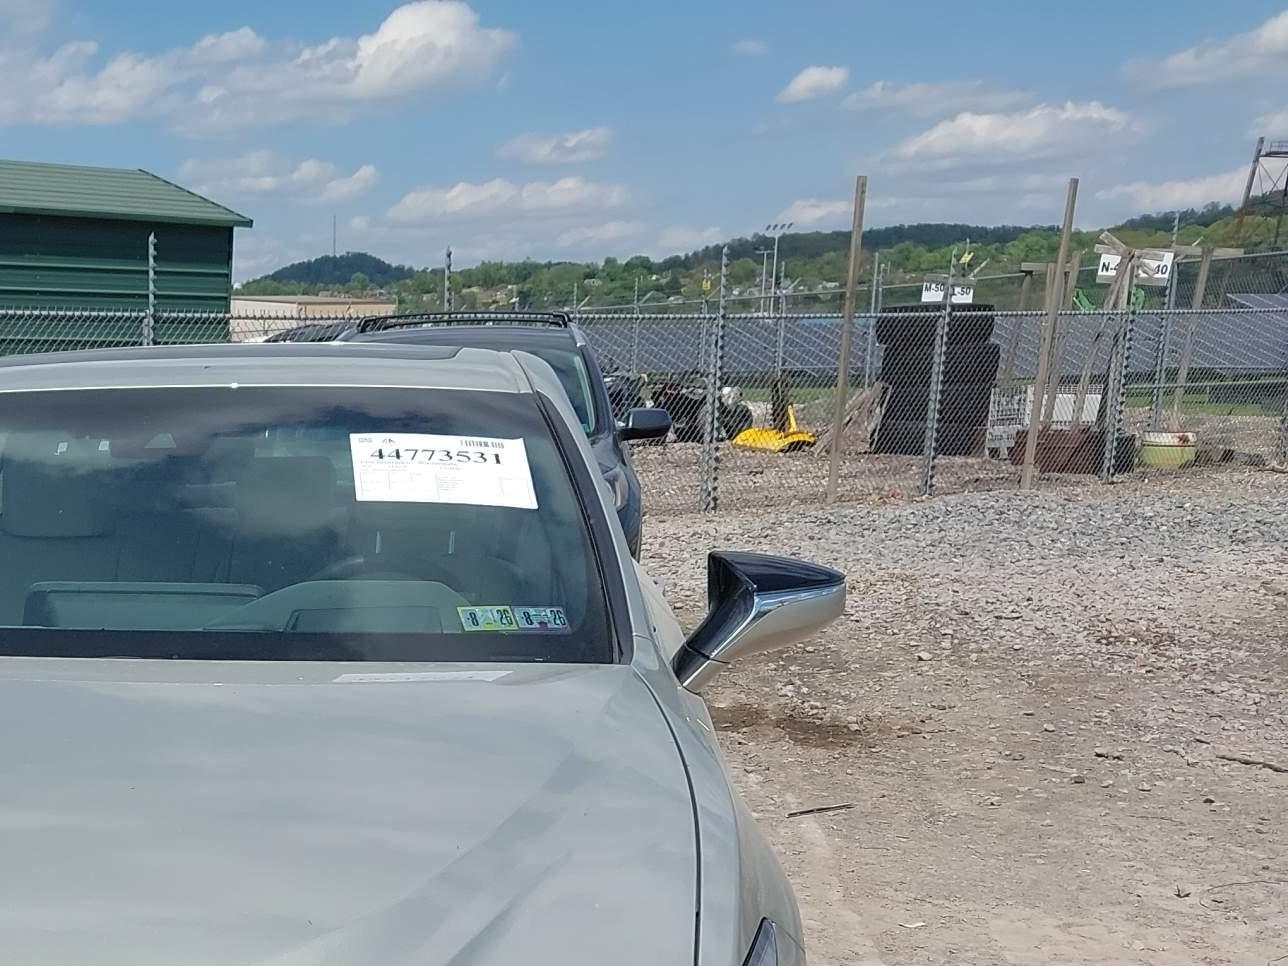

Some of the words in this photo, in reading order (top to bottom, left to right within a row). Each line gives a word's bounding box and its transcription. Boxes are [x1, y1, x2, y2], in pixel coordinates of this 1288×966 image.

[370, 447, 502, 466] 44773531
[496, 608, 514, 626] 26
[549, 609, 567, 626] 26
